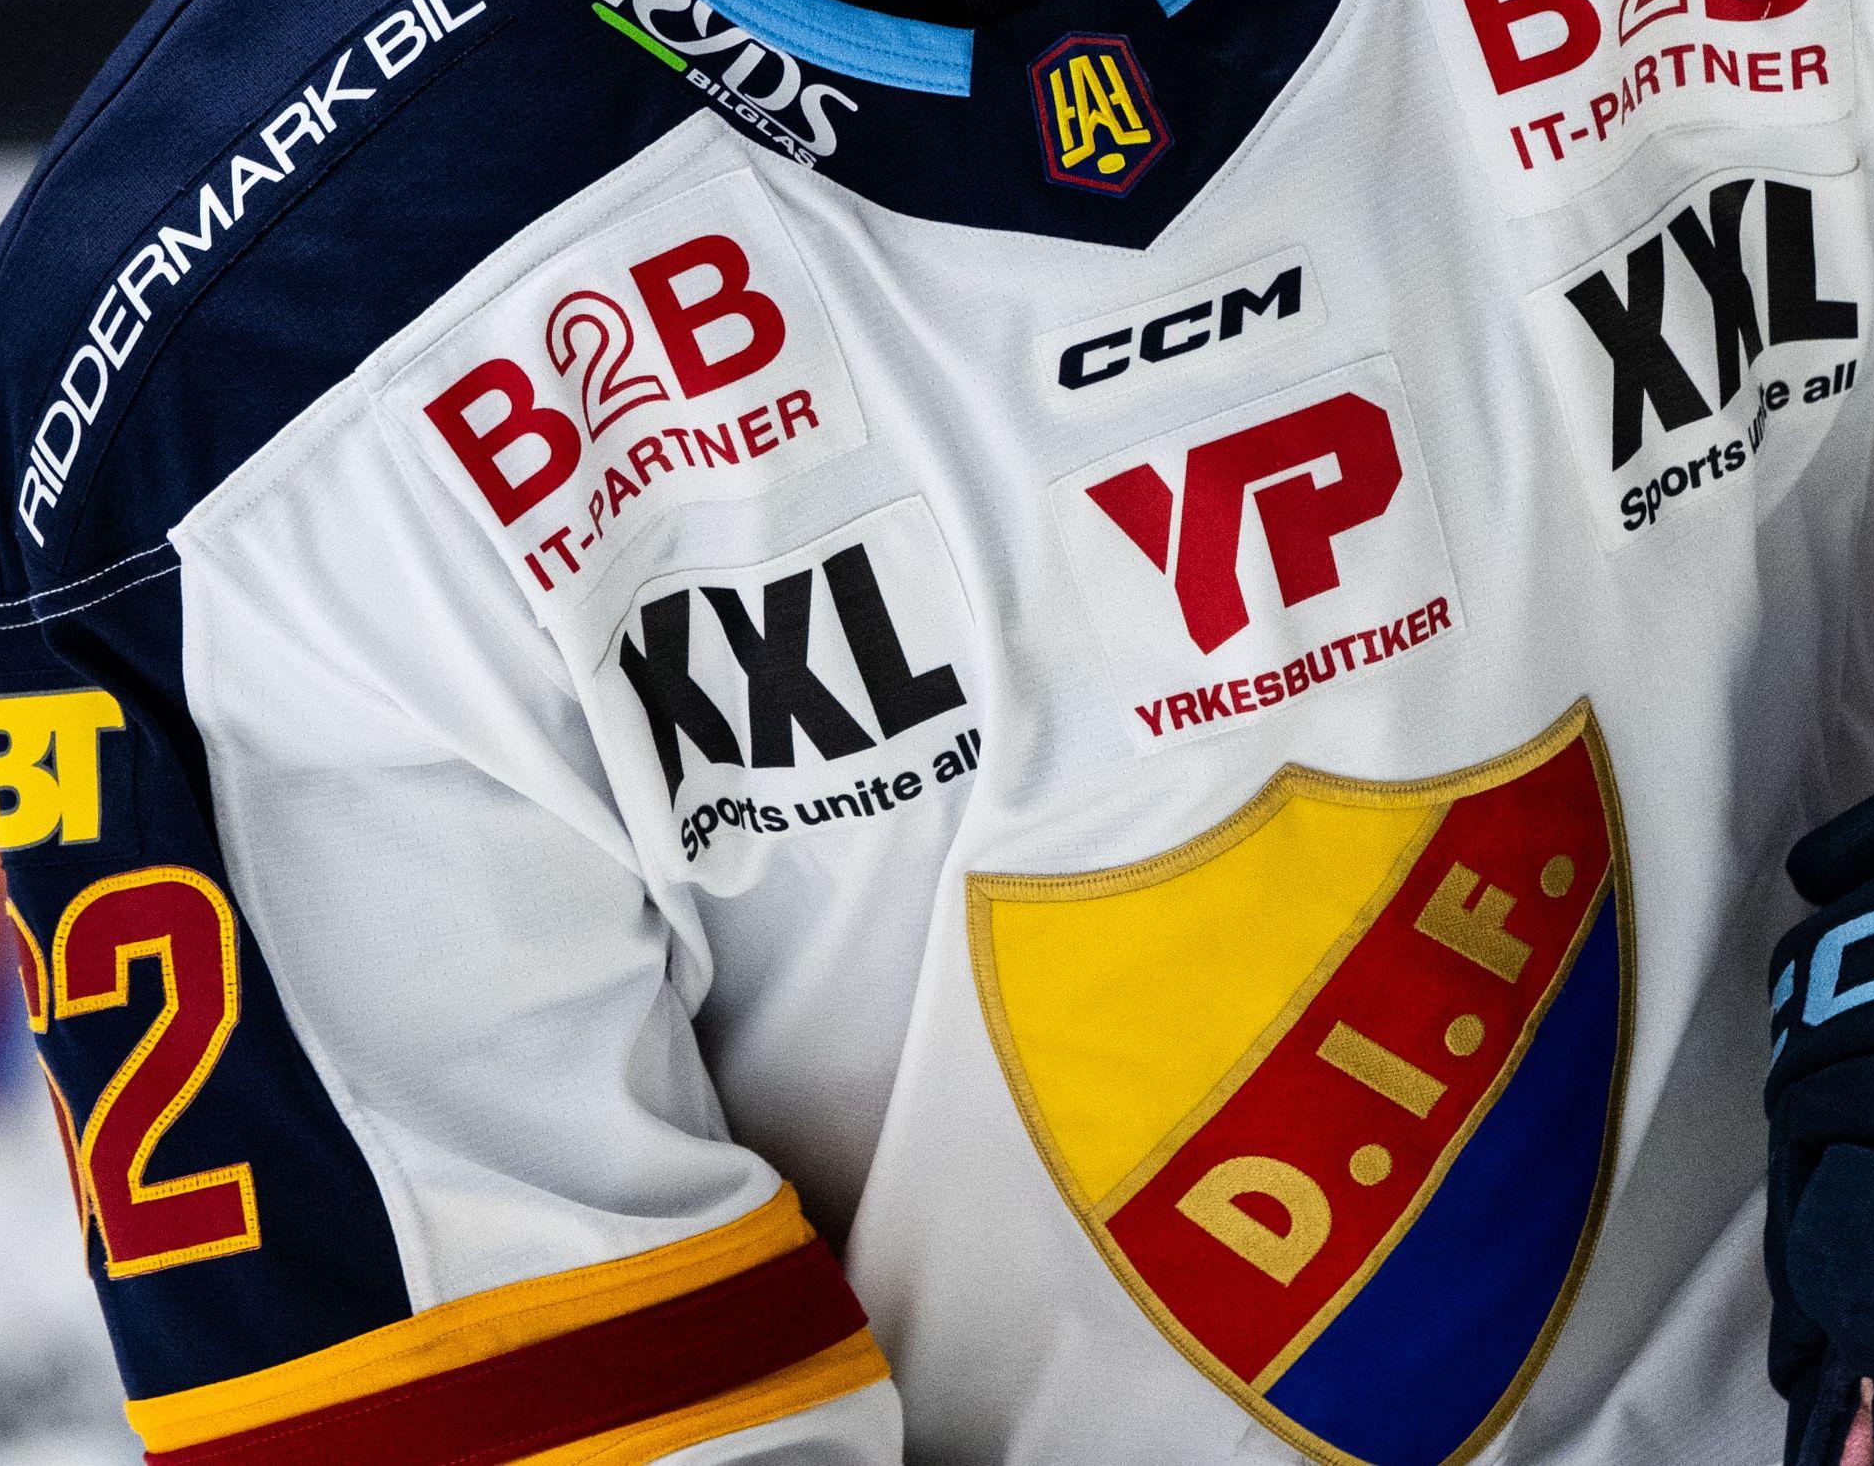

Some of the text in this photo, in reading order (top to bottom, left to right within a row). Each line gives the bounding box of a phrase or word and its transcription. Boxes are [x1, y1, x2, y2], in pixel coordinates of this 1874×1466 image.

[686, 68, 817, 169] BILGLAS
[1510, 44, 1829, 171] IT-PARTNER
[17, 46, 377, 547] RIDDERMARK
[423, 233, 787, 527] B2B
[1058, 266, 1301, 390] CCM
[1564, 179, 1858, 472] XXL
[524, 388, 819, 591] IT-PARTNER
[1084, 392, 1403, 655] YP
[1621, 440, 1746, 531] Sports
[1802, 360, 1857, 404] all
[619, 542, 966, 814] XXL
[1134, 596, 1452, 737] YRKESBUTIKER
[794, 771, 923, 825] unite
[932, 728, 981, 783] all
